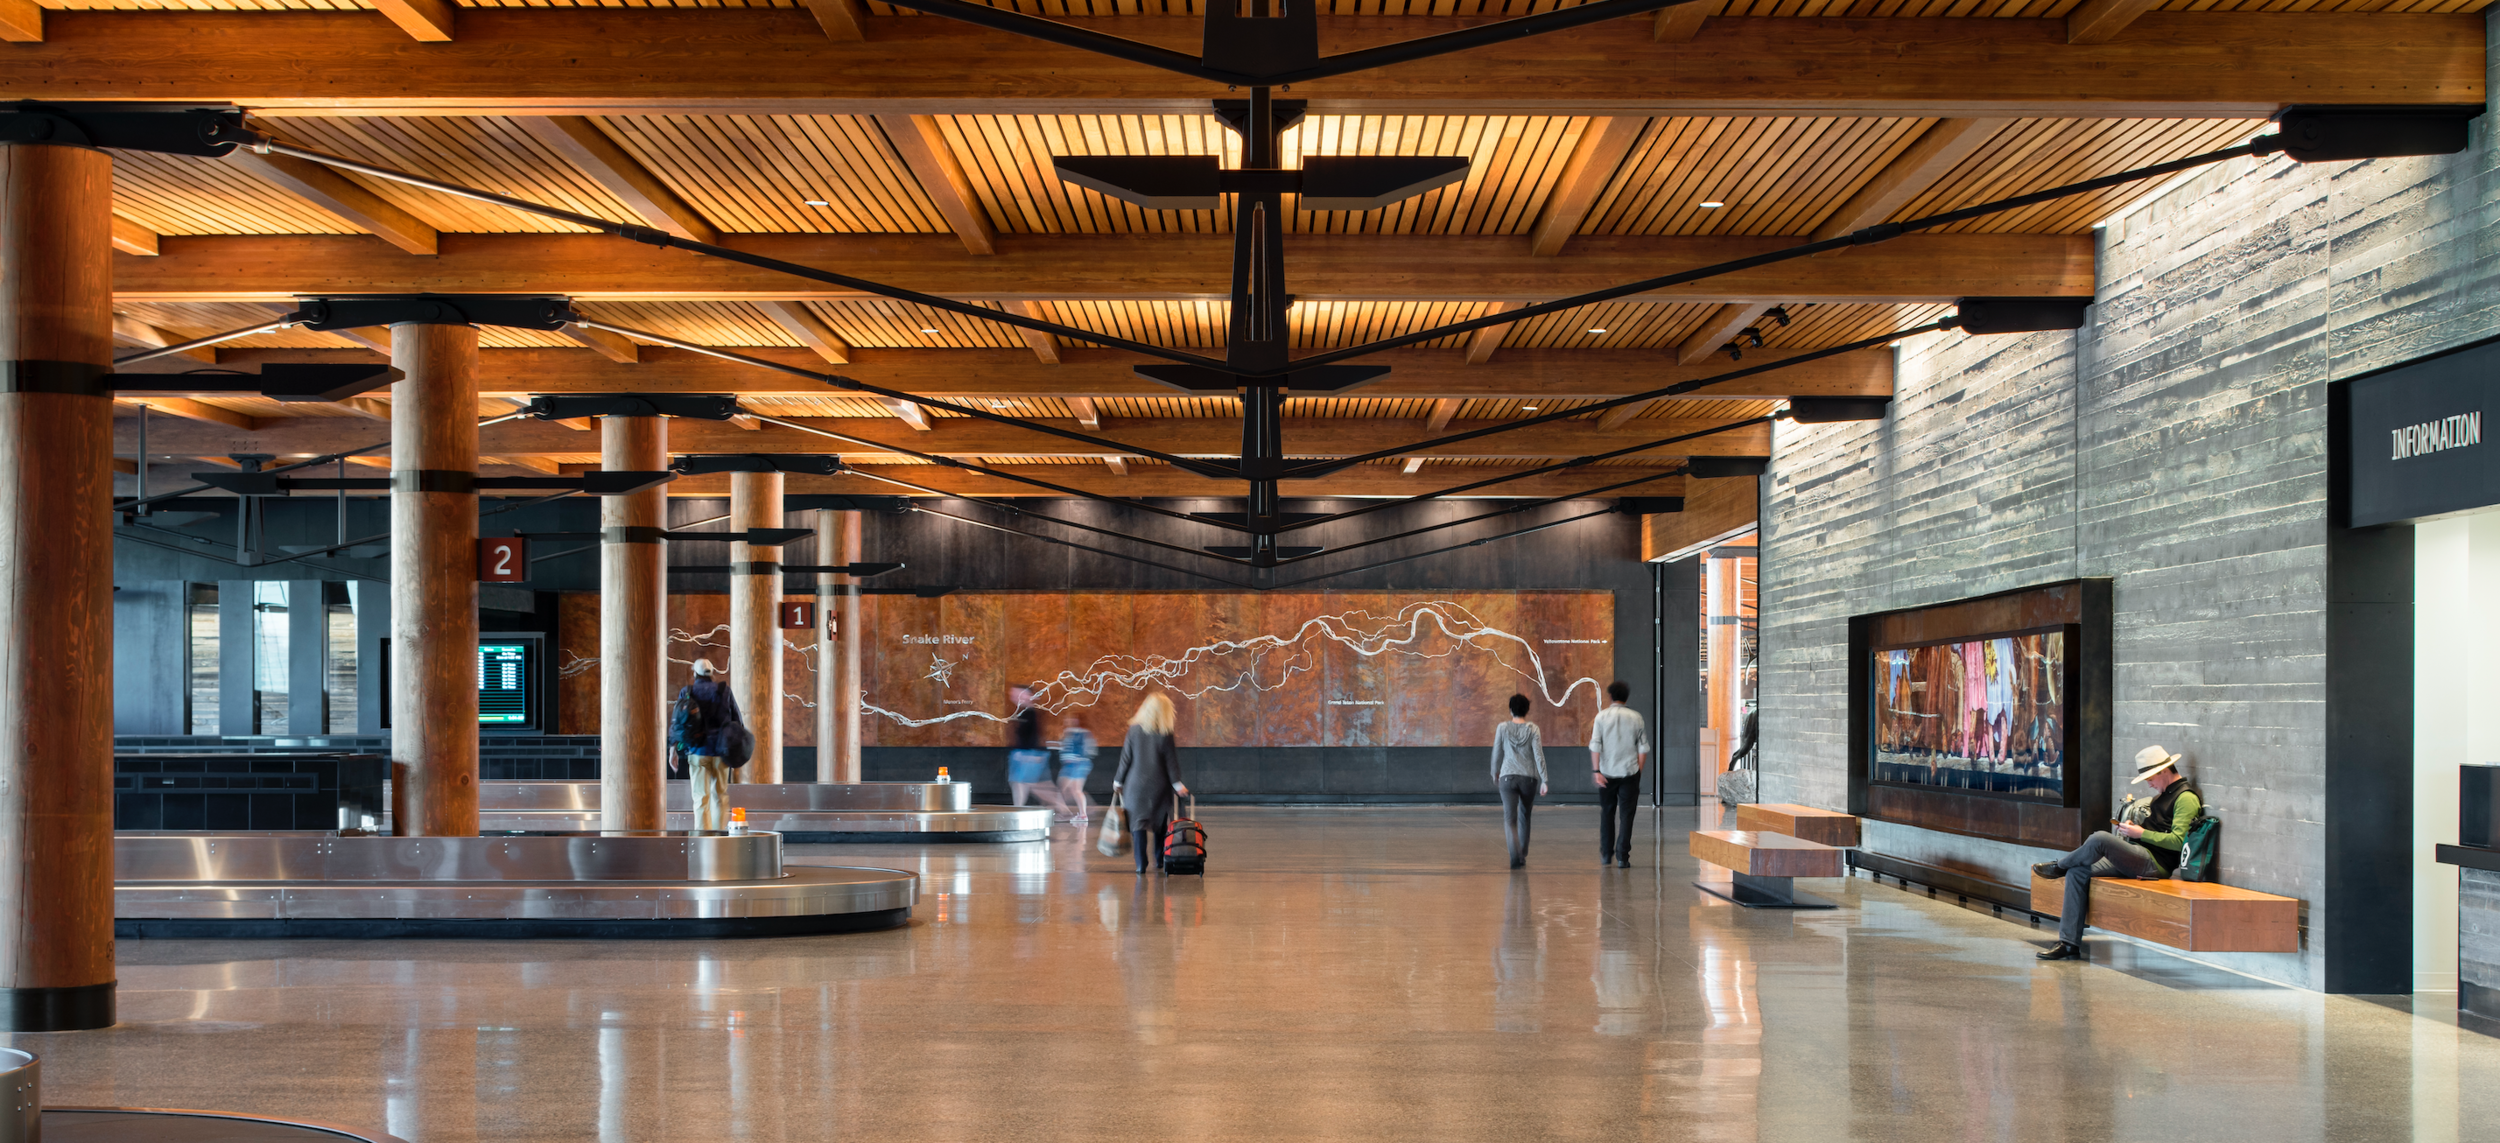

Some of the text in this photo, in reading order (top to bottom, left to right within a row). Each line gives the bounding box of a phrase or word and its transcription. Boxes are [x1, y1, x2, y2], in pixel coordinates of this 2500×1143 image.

[2391, 411, 2482, 460] INFORMATION
[494, 545, 512, 575] 2
[793, 606, 804, 625] 1
[902, 634, 975, 645] Snake River
